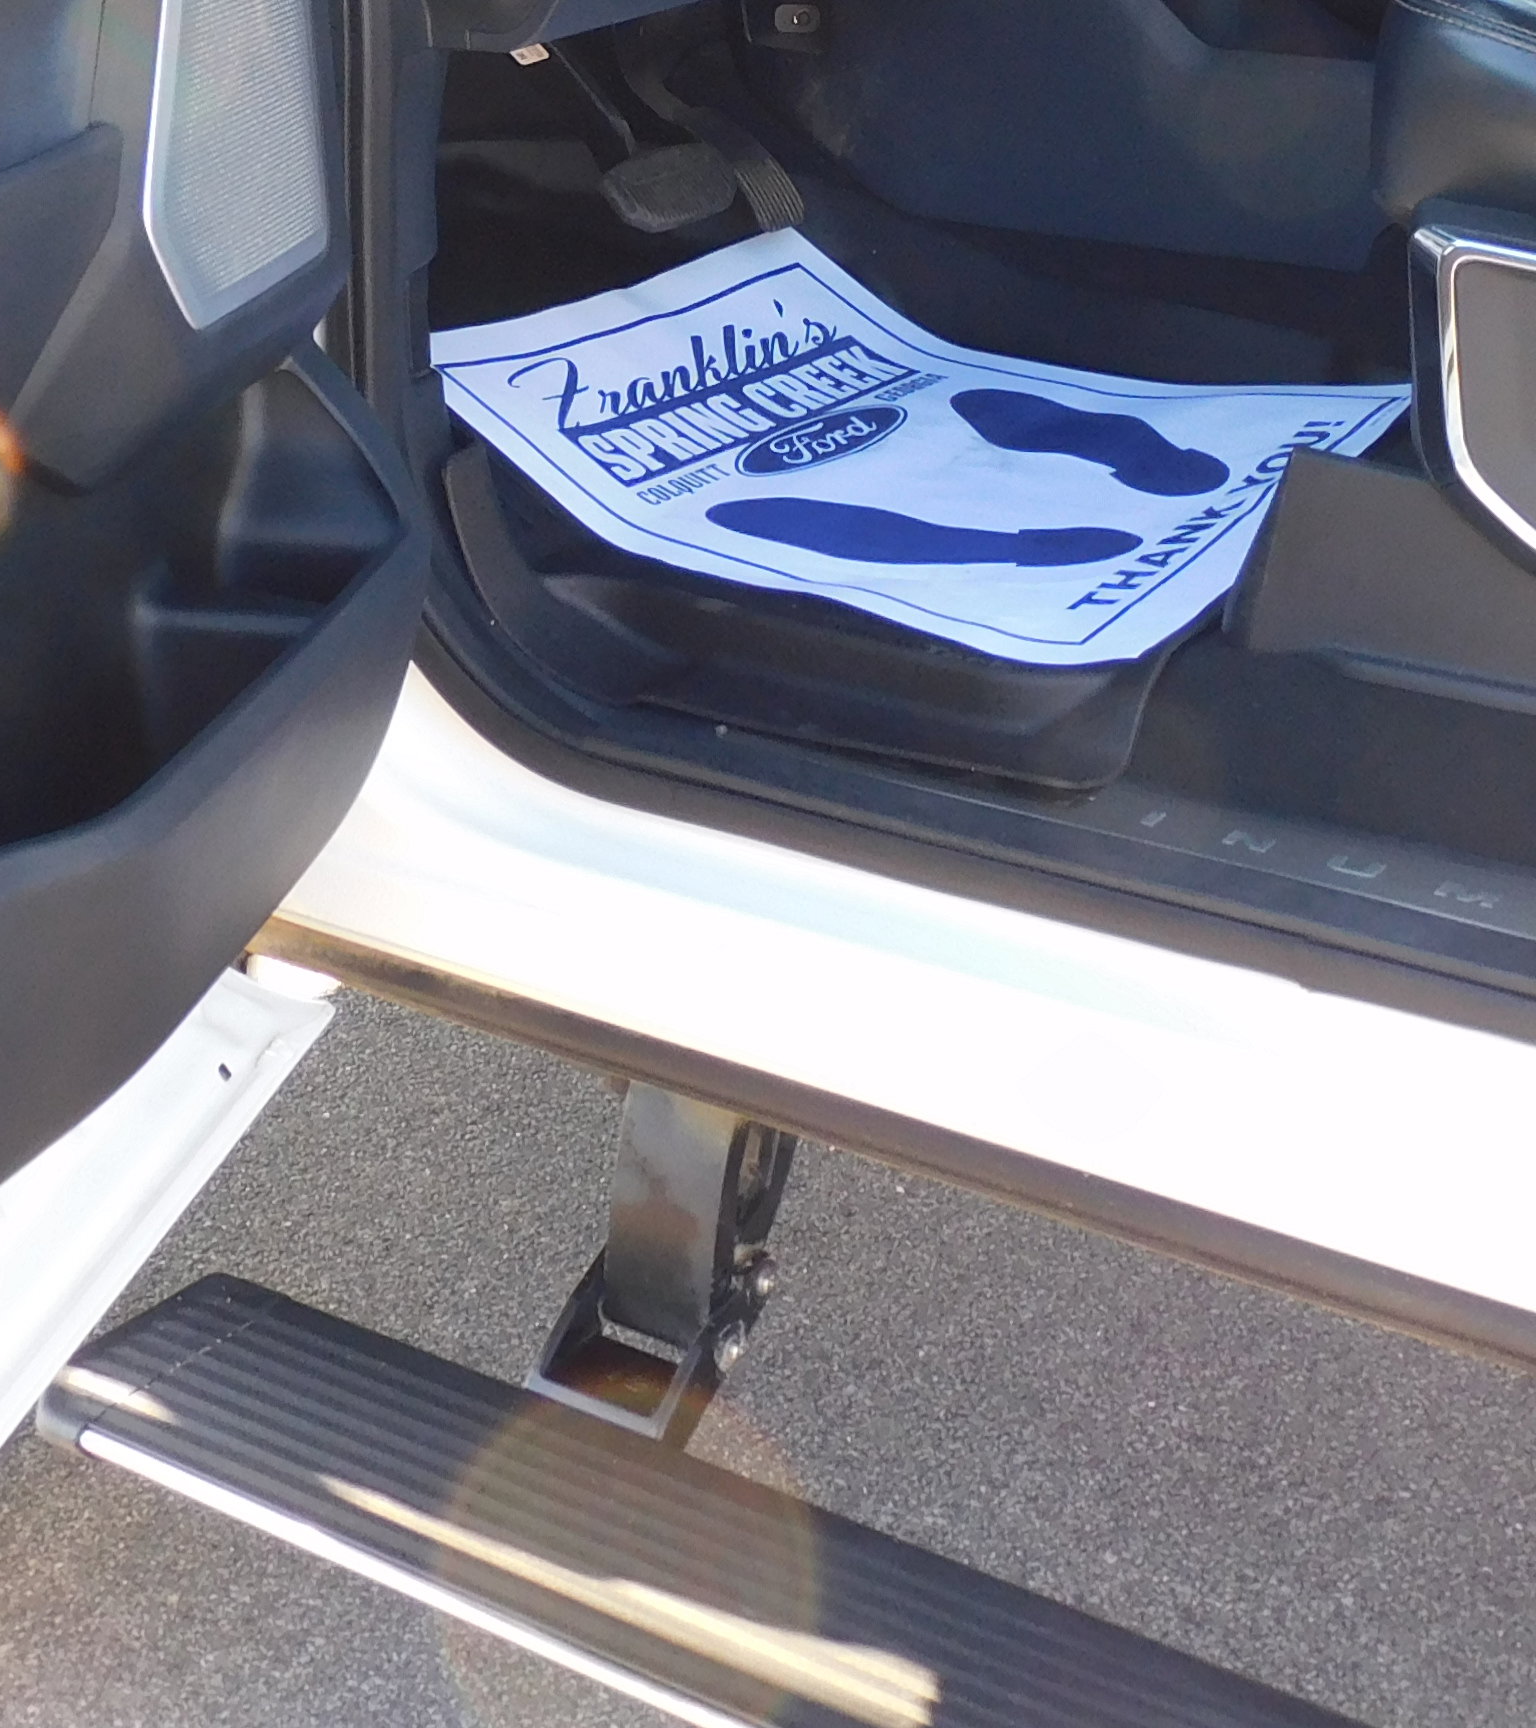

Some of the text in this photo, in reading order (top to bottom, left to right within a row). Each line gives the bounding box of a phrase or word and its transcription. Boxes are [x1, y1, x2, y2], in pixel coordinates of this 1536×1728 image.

[507, 299, 838, 431] Franklin's
[578, 344, 908, 481] SPRING CREEK
[636, 462, 733, 506] COLQUITT
[769, 415, 877, 466] Ford
[1066, 420, 1346, 610] THANK YOU!
[1138, 805, 1500, 910] INUM
